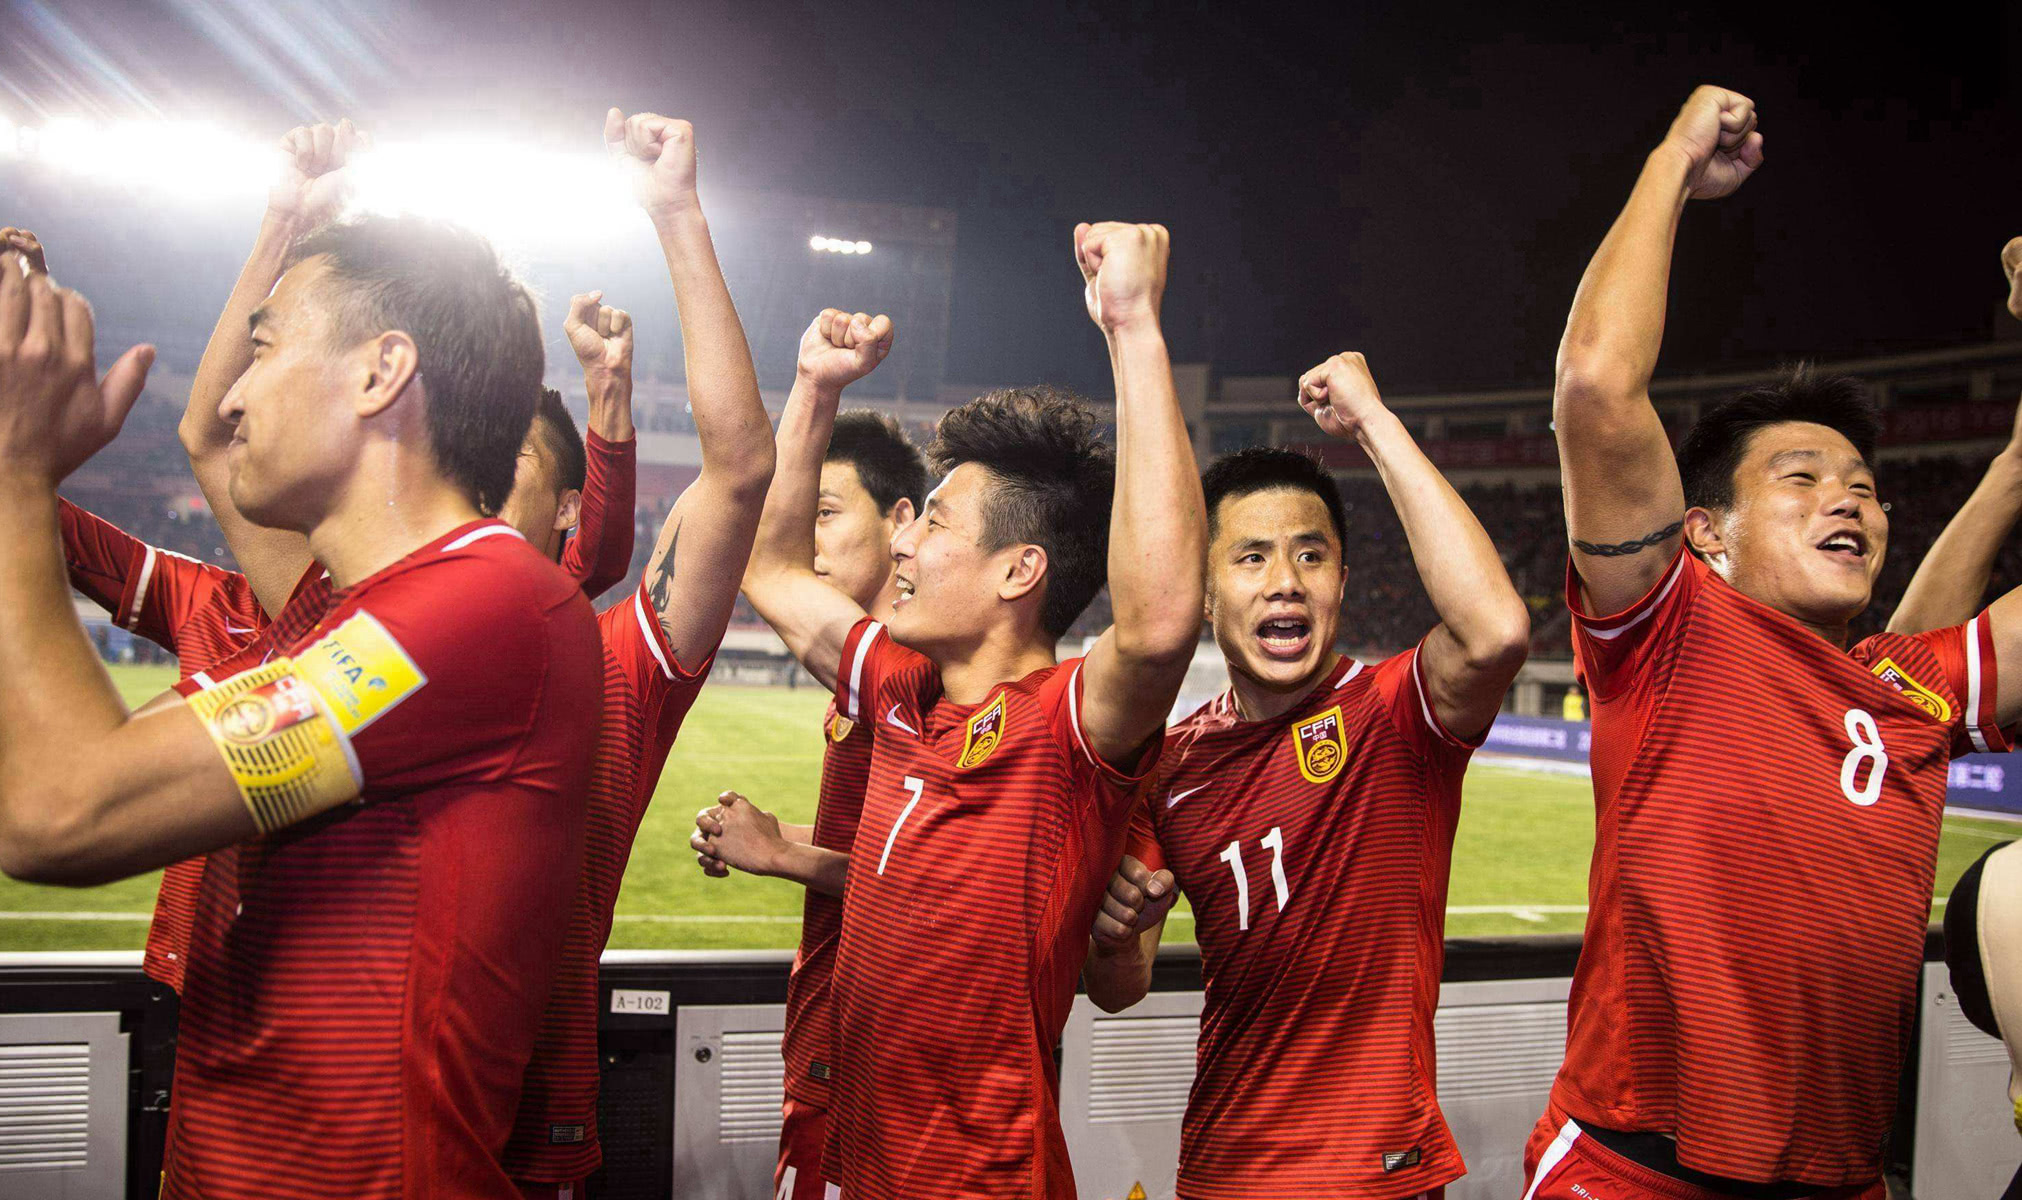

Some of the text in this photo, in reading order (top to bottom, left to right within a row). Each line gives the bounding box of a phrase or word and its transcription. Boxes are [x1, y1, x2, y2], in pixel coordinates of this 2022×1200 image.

[973, 703, 1001, 735] CFA
[1300, 715, 1336, 739] CFA
[1840, 708, 1888, 806] 8
[877, 776, 924, 876] 7
[1220, 826, 1290, 930] 11
[616, 996, 663, 1011] A-102
[1571, 1183, 1600, 1200] DRI-
